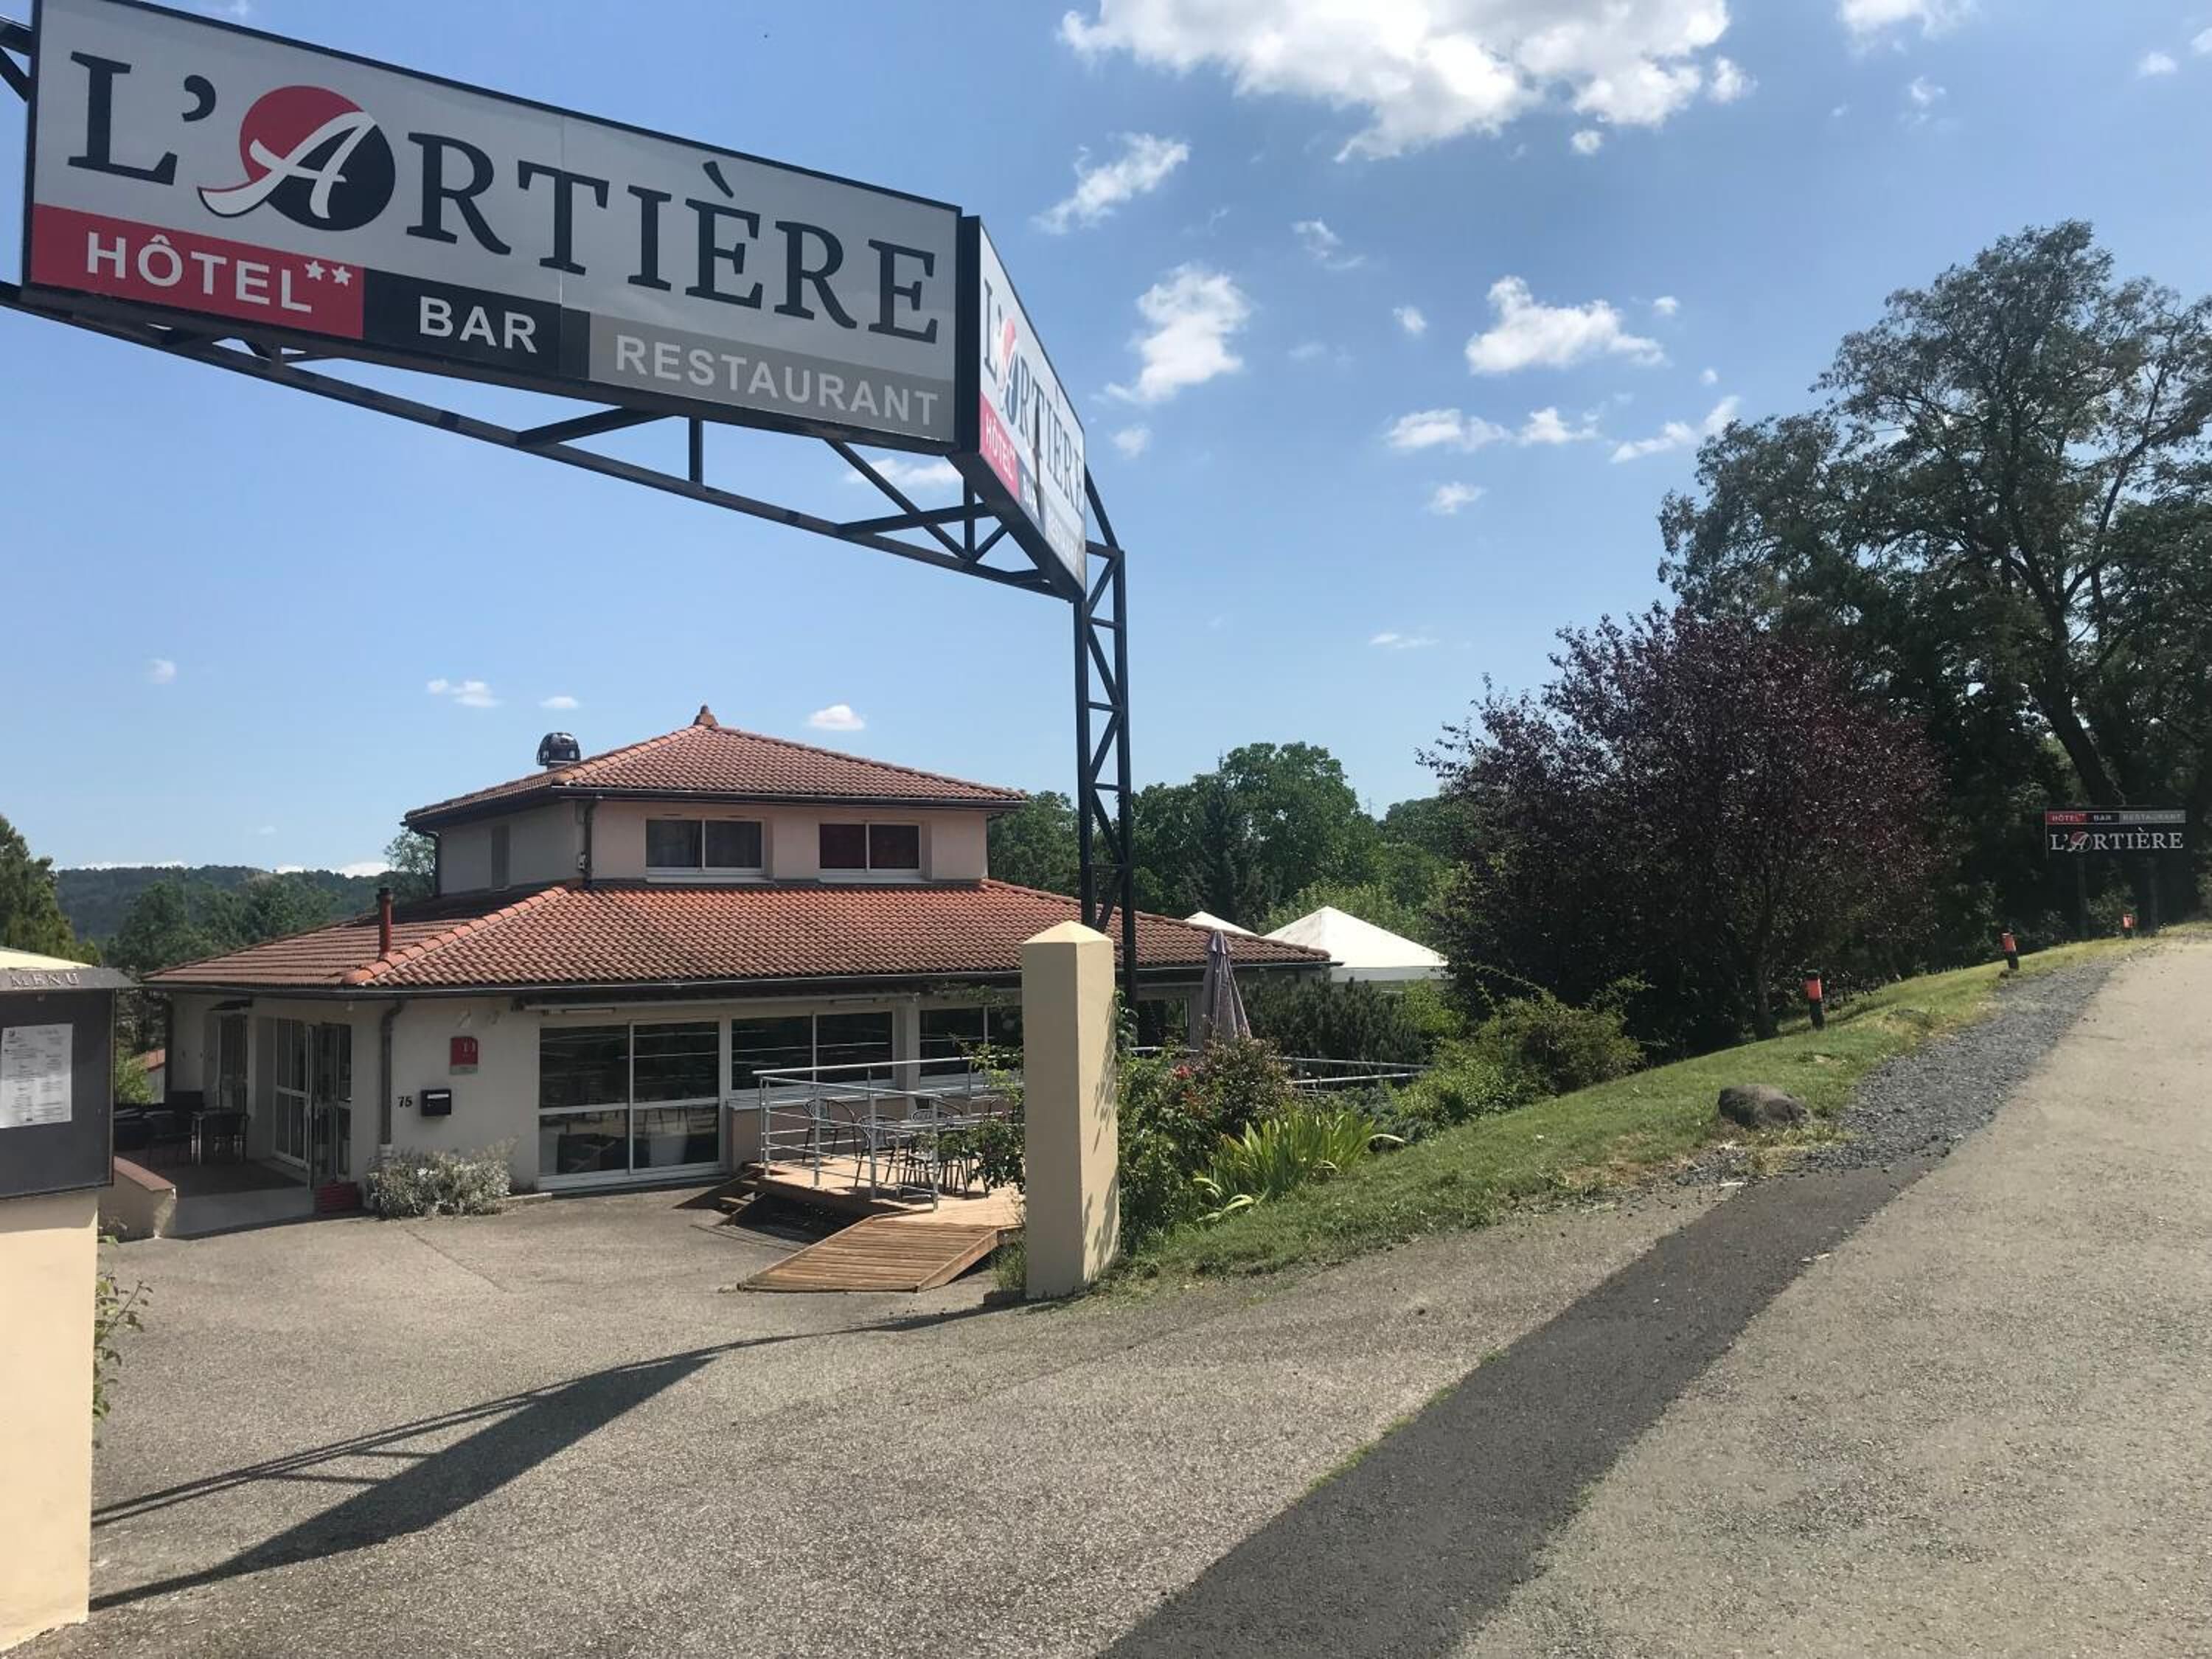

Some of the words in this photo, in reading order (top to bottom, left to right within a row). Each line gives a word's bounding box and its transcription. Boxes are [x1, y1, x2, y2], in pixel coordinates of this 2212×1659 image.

[68, 51, 939, 344] L'ARTIÈRE
[86, 231, 312, 313] HÔTEL
[419, 296, 538, 353] BAR
[616, 333, 939, 425] RESTAURANT
[2049, 827, 2183, 853] L'ARTIÈRE
[397, 1096, 413, 1107] 75
